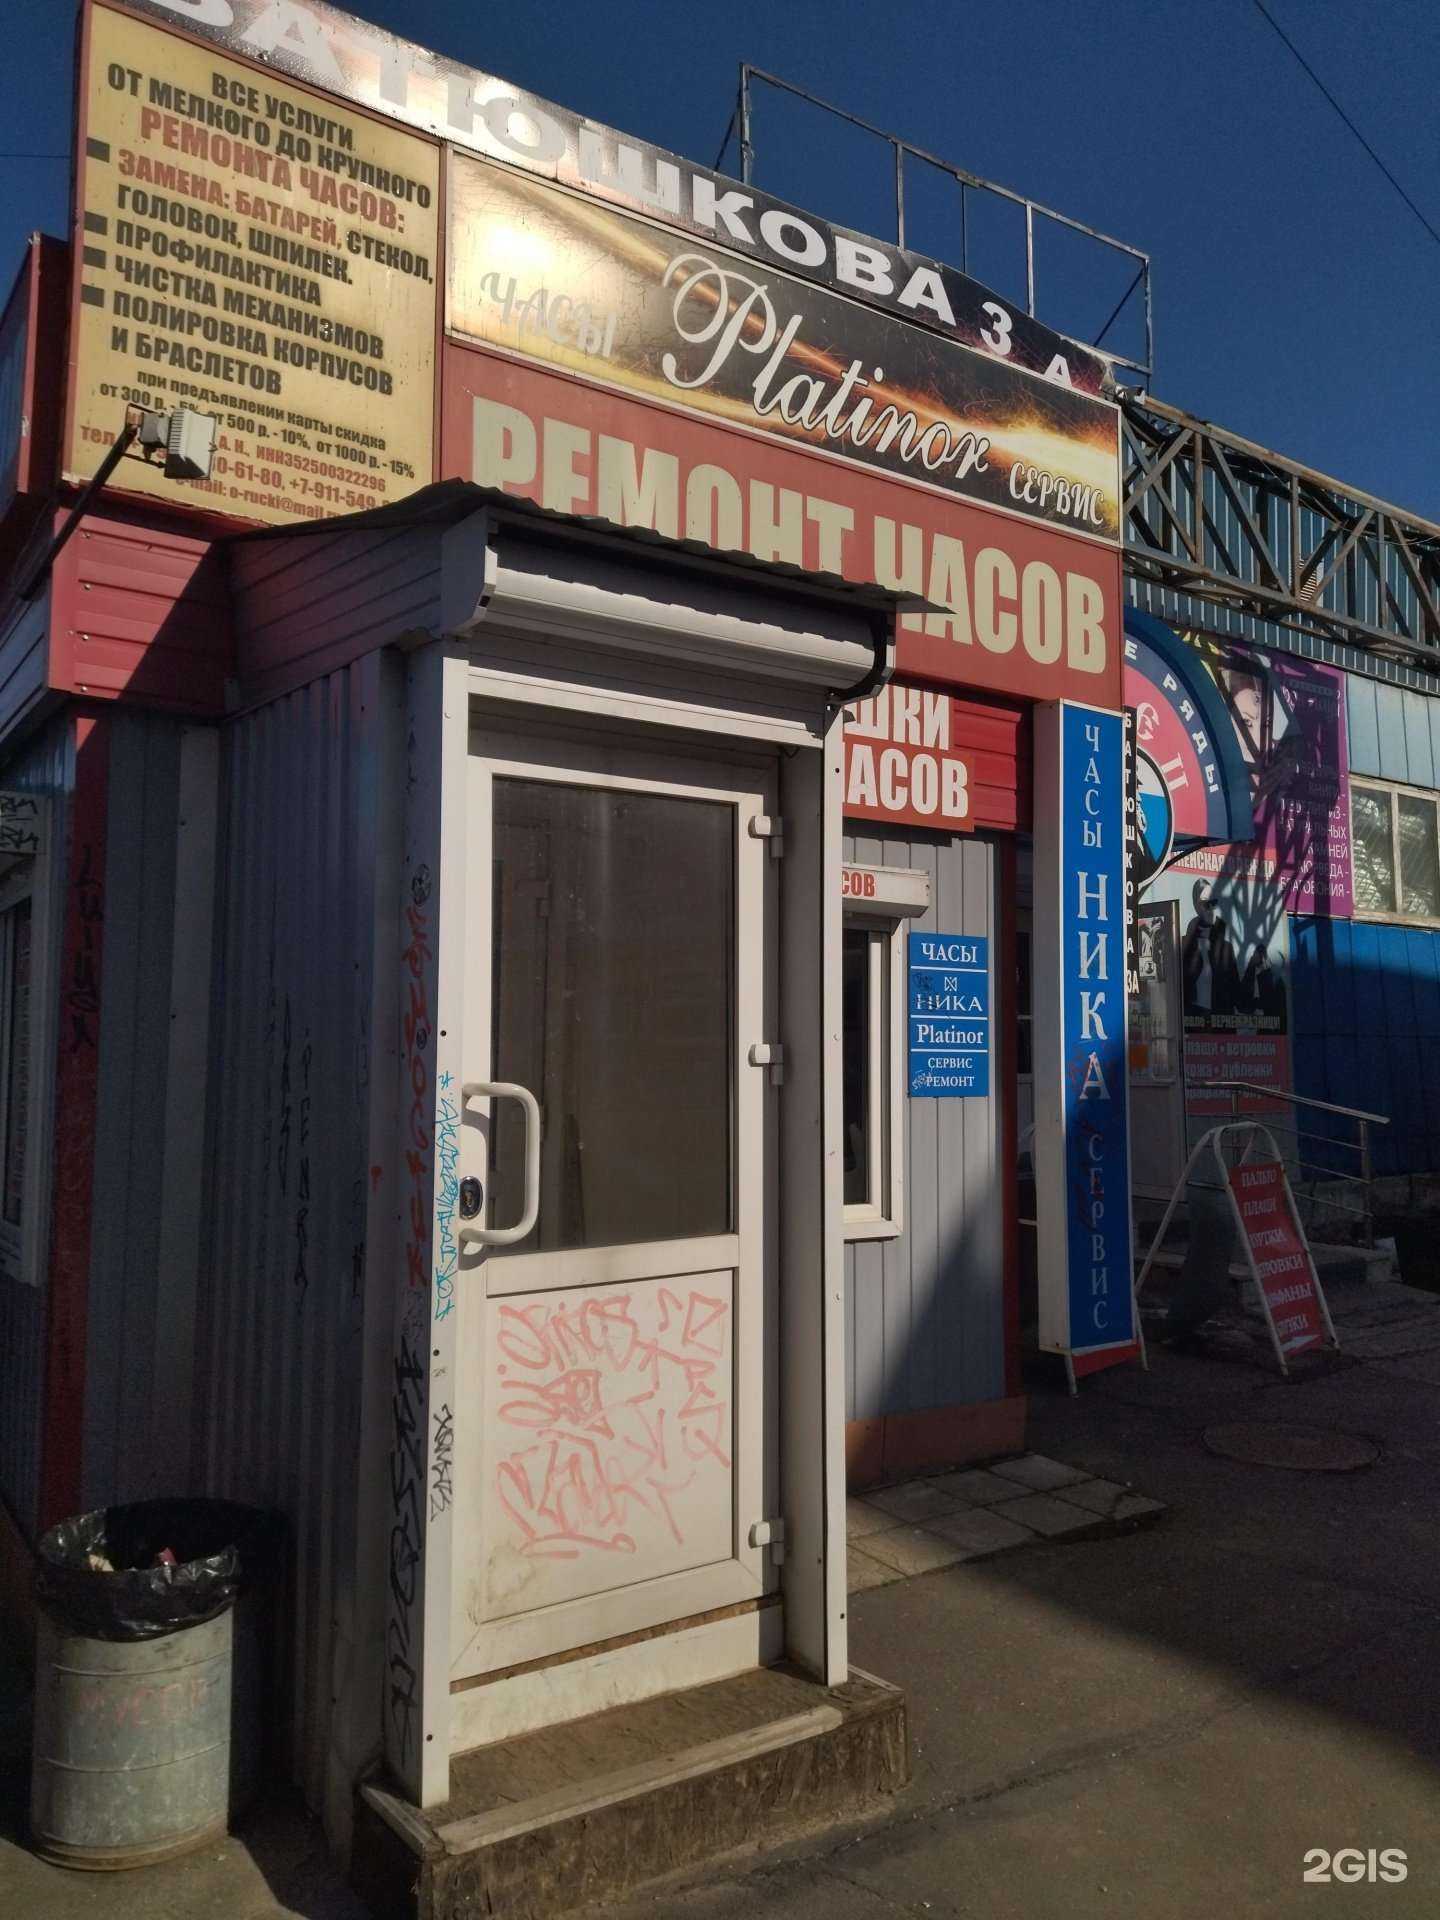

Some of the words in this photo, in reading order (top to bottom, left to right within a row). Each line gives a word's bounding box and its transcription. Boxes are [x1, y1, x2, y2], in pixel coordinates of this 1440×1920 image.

[108, 63, 143, 97] ОТ
[149, 77, 271, 147] МЕЛКОГО
[276, 129, 312, 163] ДО
[318, 143, 431, 209] КРУПНОГО
[213, 72, 260, 114] ВСЕ
[265, 94, 354, 150] УСЛУГИ
[141, 105, 292, 192] РЕМОНТА
[299, 166, 405, 234] ЧАСОВ:
[117, 183, 243, 249] ГОЛОВОК,
[248, 227, 353, 285] ШПИЛЕК.
[118, 148, 230, 210] ЗАМЕНА:
[235, 189, 342, 251] БАТАРЕЙ,
[346, 229, 434, 285] СТЕКОЛ,
[115, 254, 218, 308] ЧИСТКА
[223, 286, 384, 360] МЕХАНИЗМОВ
[116, 219, 322, 307] ПРОФИЛАКТИКА
[113, 290, 268, 358] ПОЛИРОВКА
[273, 336, 394, 396] КОРПУСОВ
[480, 271, 618, 358] ЧАСЫ
[980, 301, 1013, 356] 3
[111, 325, 129, 354] И
[135, 331, 283, 396] БРАСЛЕТОВ
[661, 252, 992, 480] Platinor
[100, 382, 118, 398] от
[121, 385, 151, 406] 300
[154, 396, 167, 411] р.
[227, 416, 255, 434] 500
[257, 425, 270, 438] р.
[316, 440, 333, 455] от
[335, 444, 366, 465] 1000
[368, 455, 381, 470] р.
[389, 459, 416, 479] 15%
[137, 371, 167, 389] при
[170, 381, 285, 420] предъявлении
[287, 410, 333, 436] карты
[335, 424, 387, 451] скидка
[472, 395, 855, 576] РЕМОНТ
[873, 516, 1107, 676] ЧАСОВ
[1009, 461, 1104, 526] СЕРВИС
[843, 684, 950, 751] ШКИ
[1161, 672, 1220, 793] РЯДЫ
[842, 741, 969, 818] АСОВ
[1081, 723, 1103, 849] ЧАСЫ
[1123, 712, 1136, 954] БАТЮШКОВА
[841, 870, 876, 898] СОВ
[921, 942, 977, 964] ЧАСЫ
[1076, 870, 1112, 1101] НИКА
[916, 993, 984, 1012] НИКА
[916, 1023, 984, 1045] Platinor
[926, 1076, 975, 1088] РЕМОНТ
[927, 1057, 973, 1069] СЕРВИС
[1087, 1134, 1111, 1330] СЕРВИС
